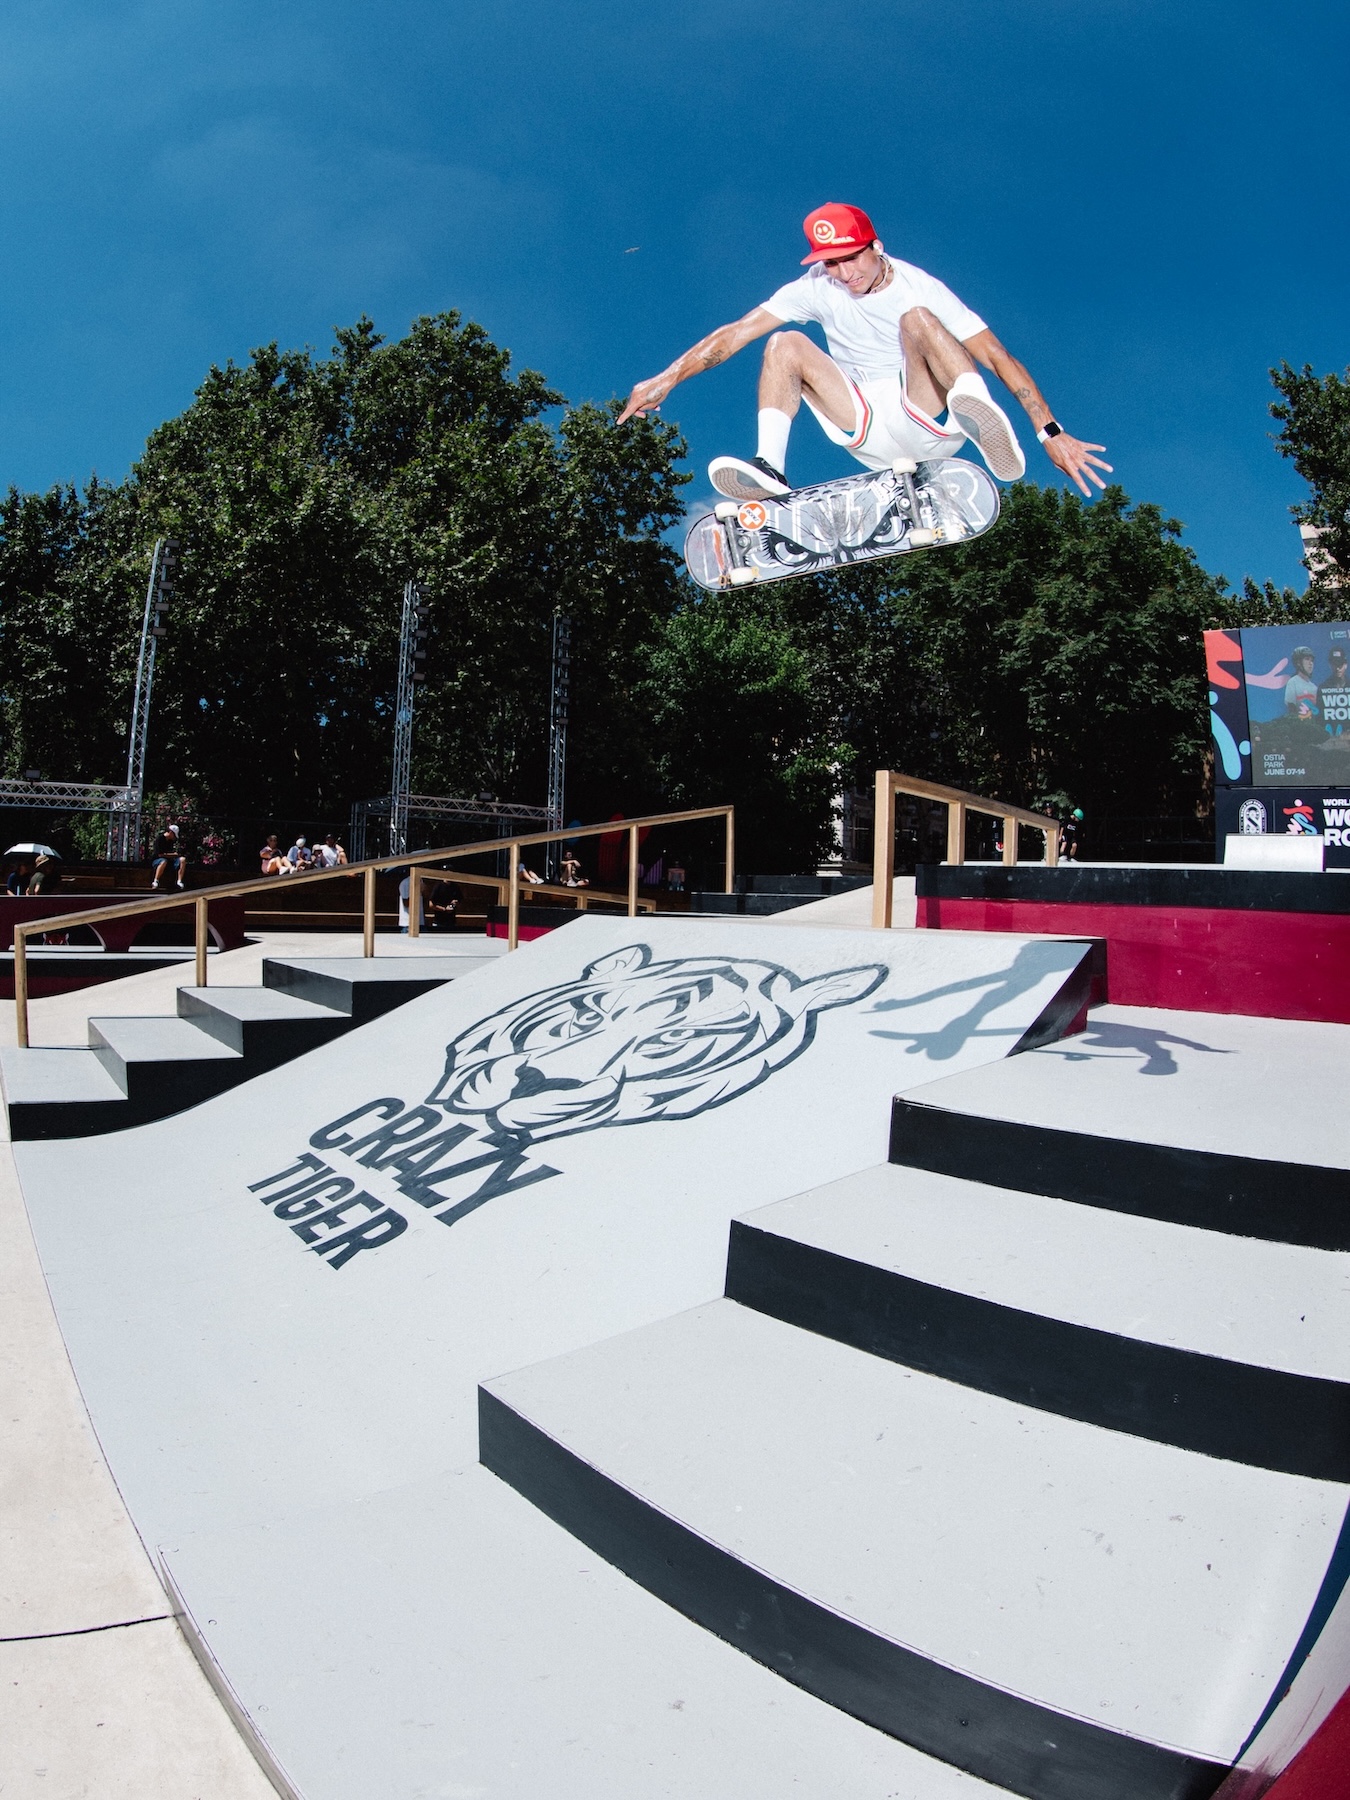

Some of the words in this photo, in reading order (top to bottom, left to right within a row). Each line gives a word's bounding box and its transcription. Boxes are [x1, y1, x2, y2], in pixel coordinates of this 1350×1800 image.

[1322, 694, 1350, 707] WO
[1324, 707, 1350, 721] RO
[1264, 768, 1285, 776] JUNE
[1323, 798, 1350, 806] WORL
[309, 1097, 564, 1227] CRAZY
[246, 1151, 408, 1270] TIGER
